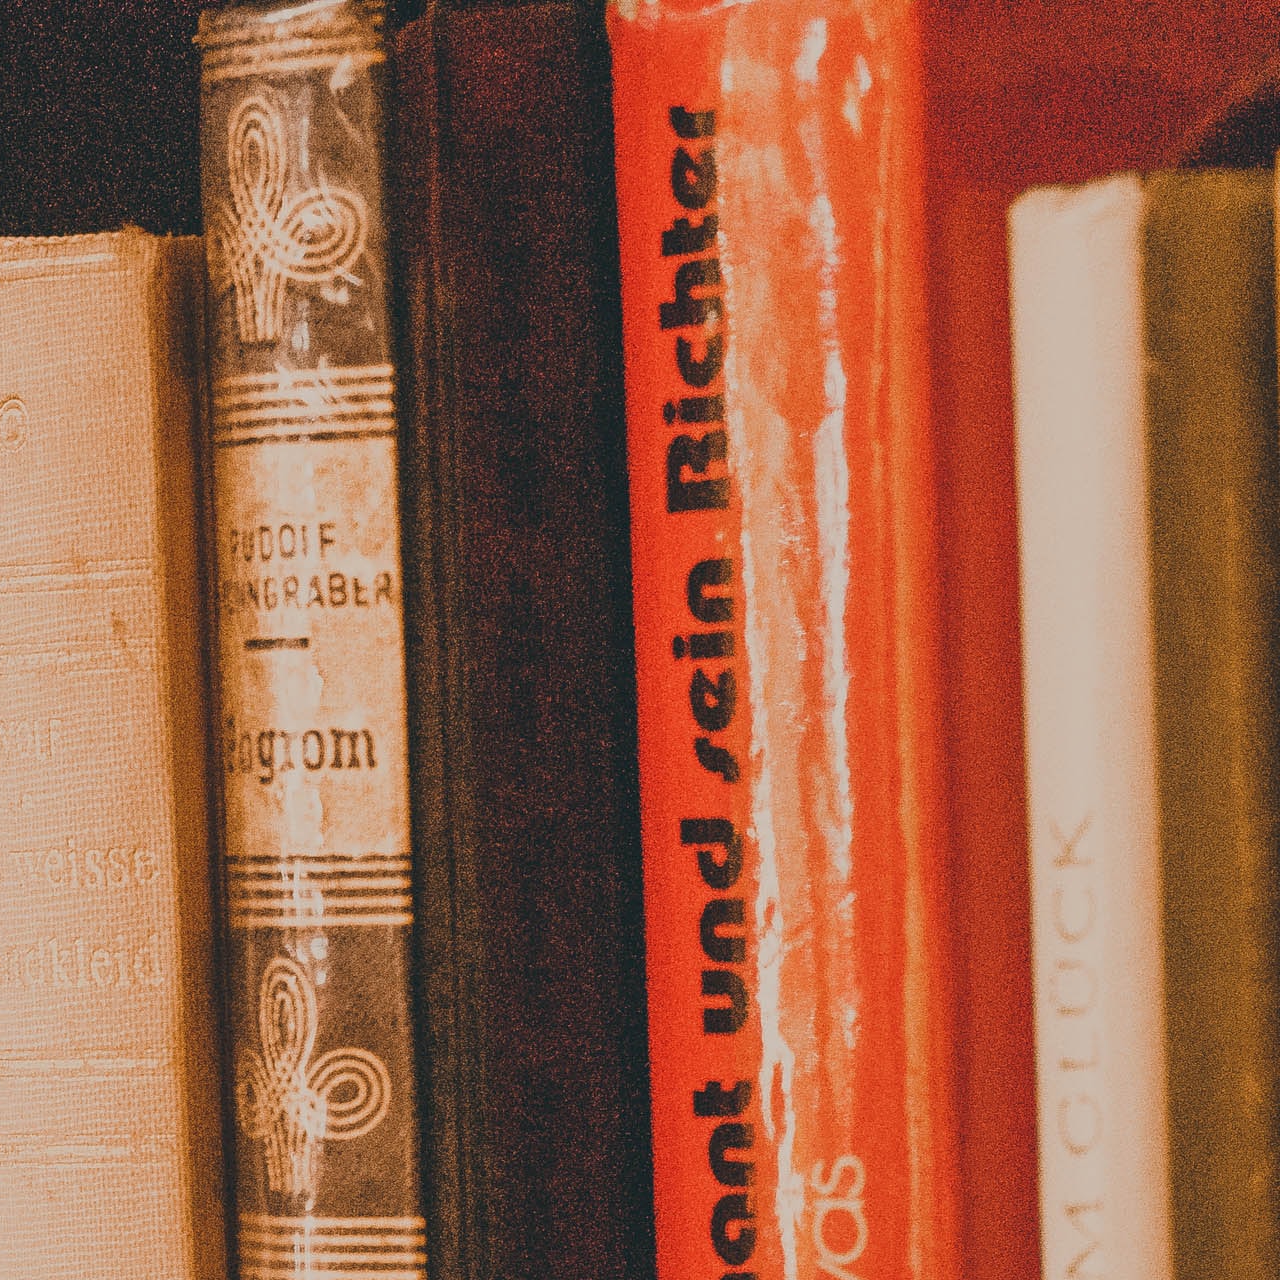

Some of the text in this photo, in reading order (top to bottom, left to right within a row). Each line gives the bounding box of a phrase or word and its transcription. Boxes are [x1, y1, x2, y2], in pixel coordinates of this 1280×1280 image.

[660, 106, 731, 514] Richter
[671, 557, 738, 784] sein
[680, 817, 752, 1034] und
